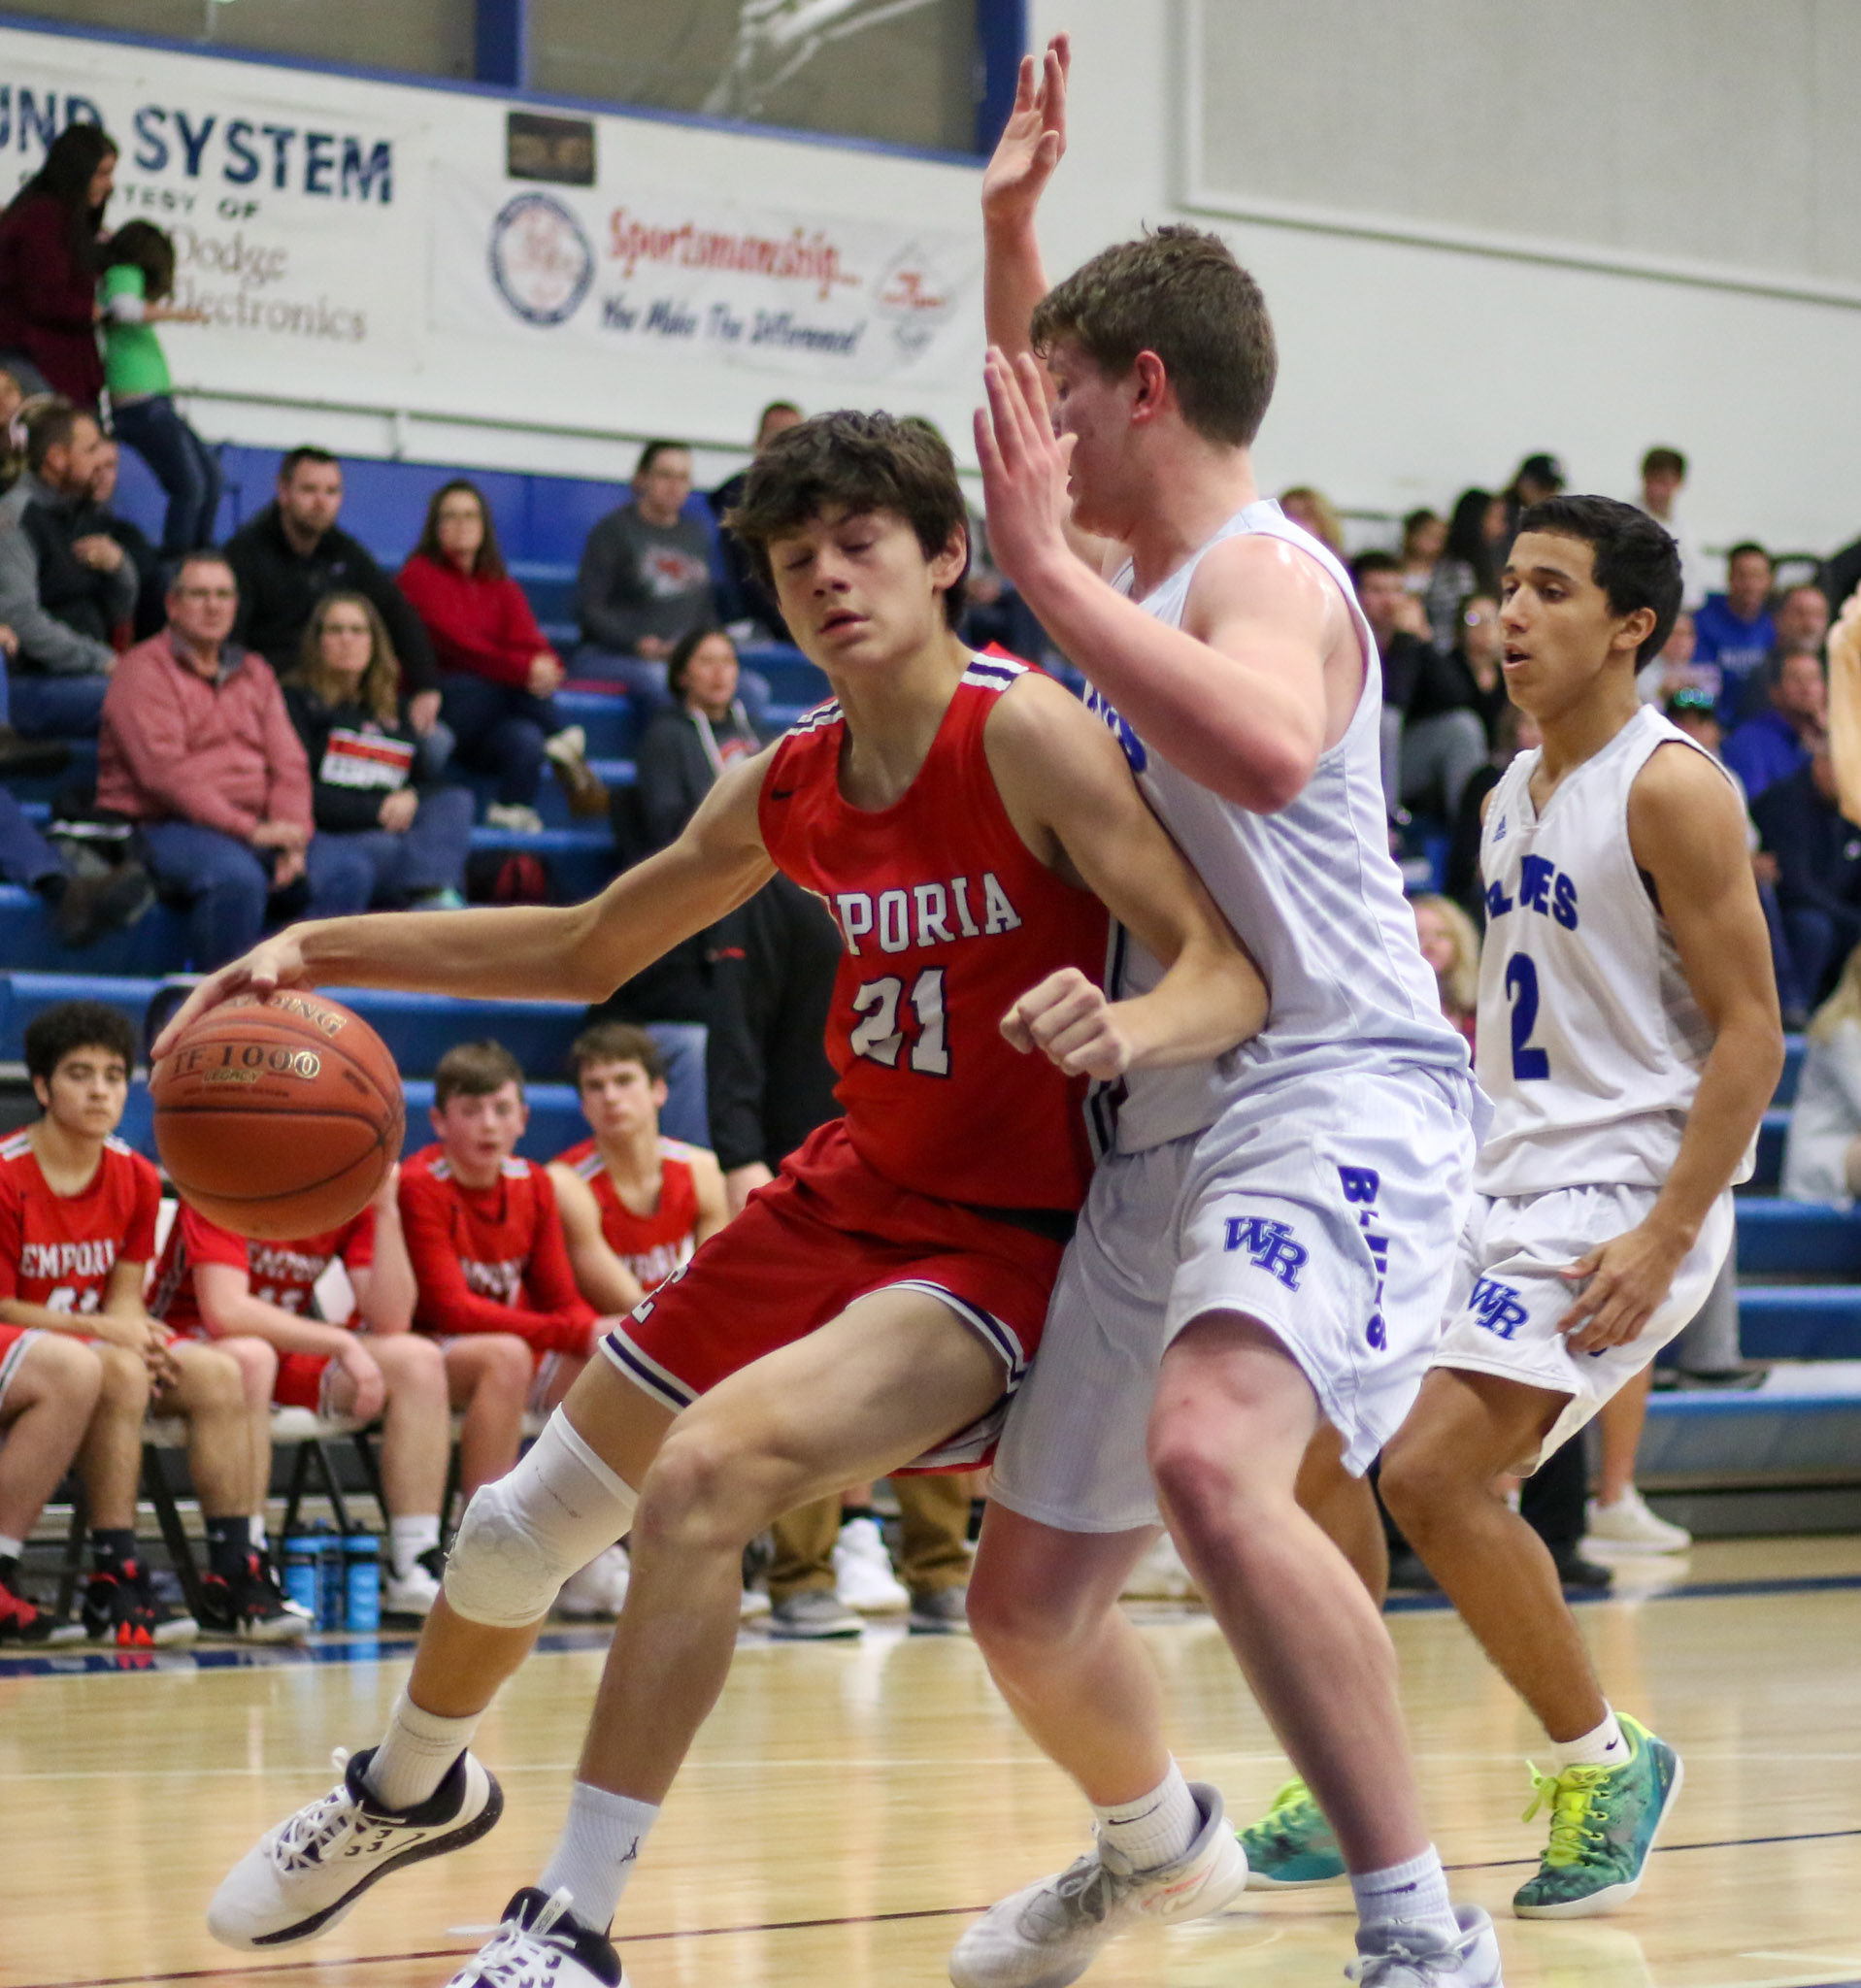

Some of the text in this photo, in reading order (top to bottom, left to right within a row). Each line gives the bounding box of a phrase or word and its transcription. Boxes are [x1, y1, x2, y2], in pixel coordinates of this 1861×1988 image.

[133, 103, 395, 206] SYSTEM
[217, 197, 260, 221] OF
[175, 277, 368, 344] lectronics
[826, 872, 1022, 956] PORIA
[849, 965, 953, 1079] 21
[1506, 951, 1550, 1080] 2
[220, 1045, 320, 1079] 1000
